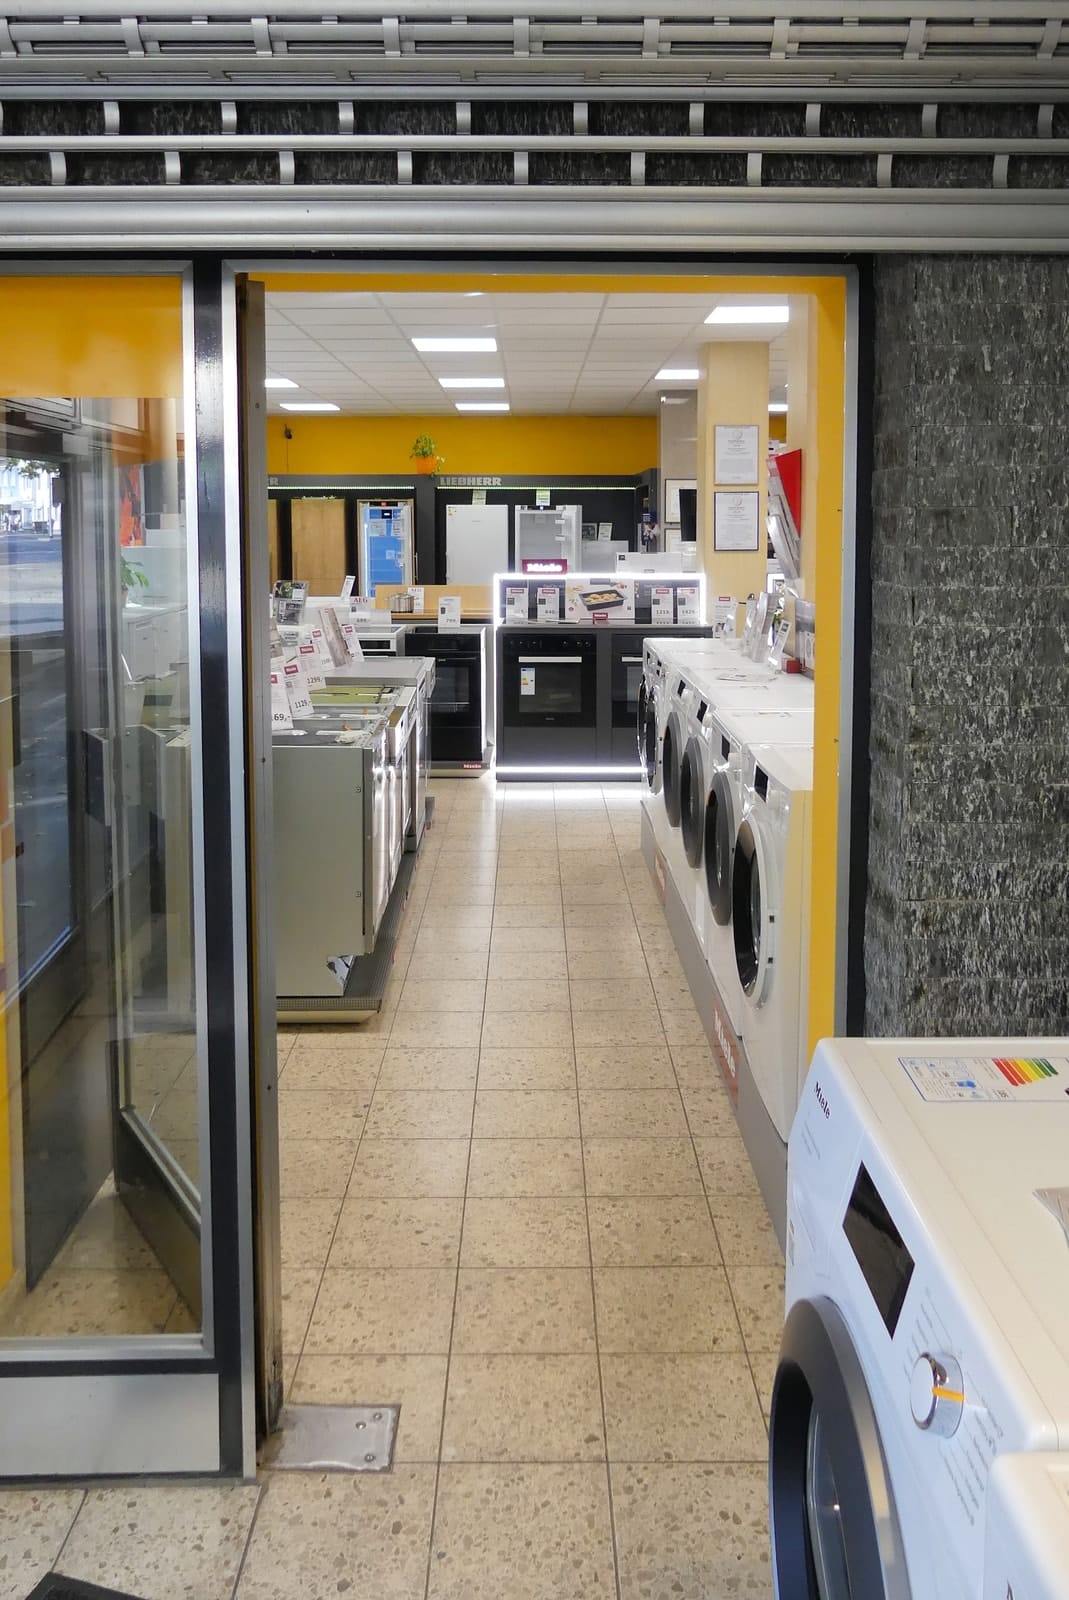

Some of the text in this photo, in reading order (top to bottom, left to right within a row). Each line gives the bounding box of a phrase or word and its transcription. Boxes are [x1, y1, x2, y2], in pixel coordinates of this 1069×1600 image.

[439, 476, 502, 486] LIEBHERR
[294, 699, 312, 709] 1129,-
[714, 1007, 736, 1078] Miele
[813, 1081, 831, 1119] Miele
